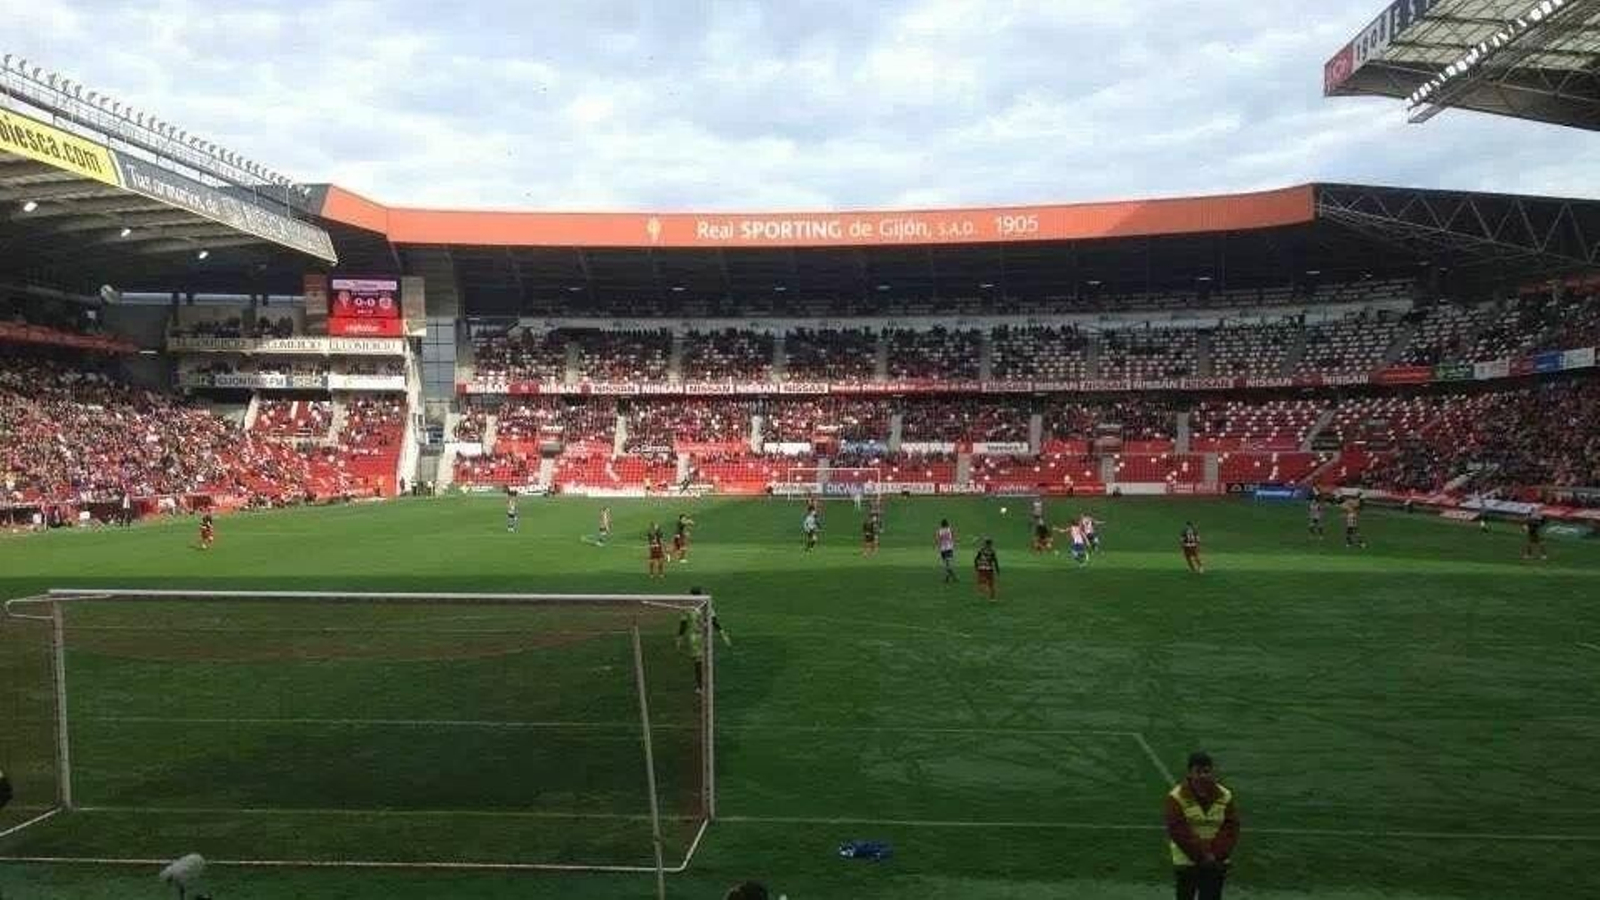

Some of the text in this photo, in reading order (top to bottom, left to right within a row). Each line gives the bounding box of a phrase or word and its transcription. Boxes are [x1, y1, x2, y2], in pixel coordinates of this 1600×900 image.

[698, 218, 734, 239] Real
[741, 218, 842, 239] SPORTING
[850, 218, 873, 238] de
[996, 214, 1039, 234] 1905
